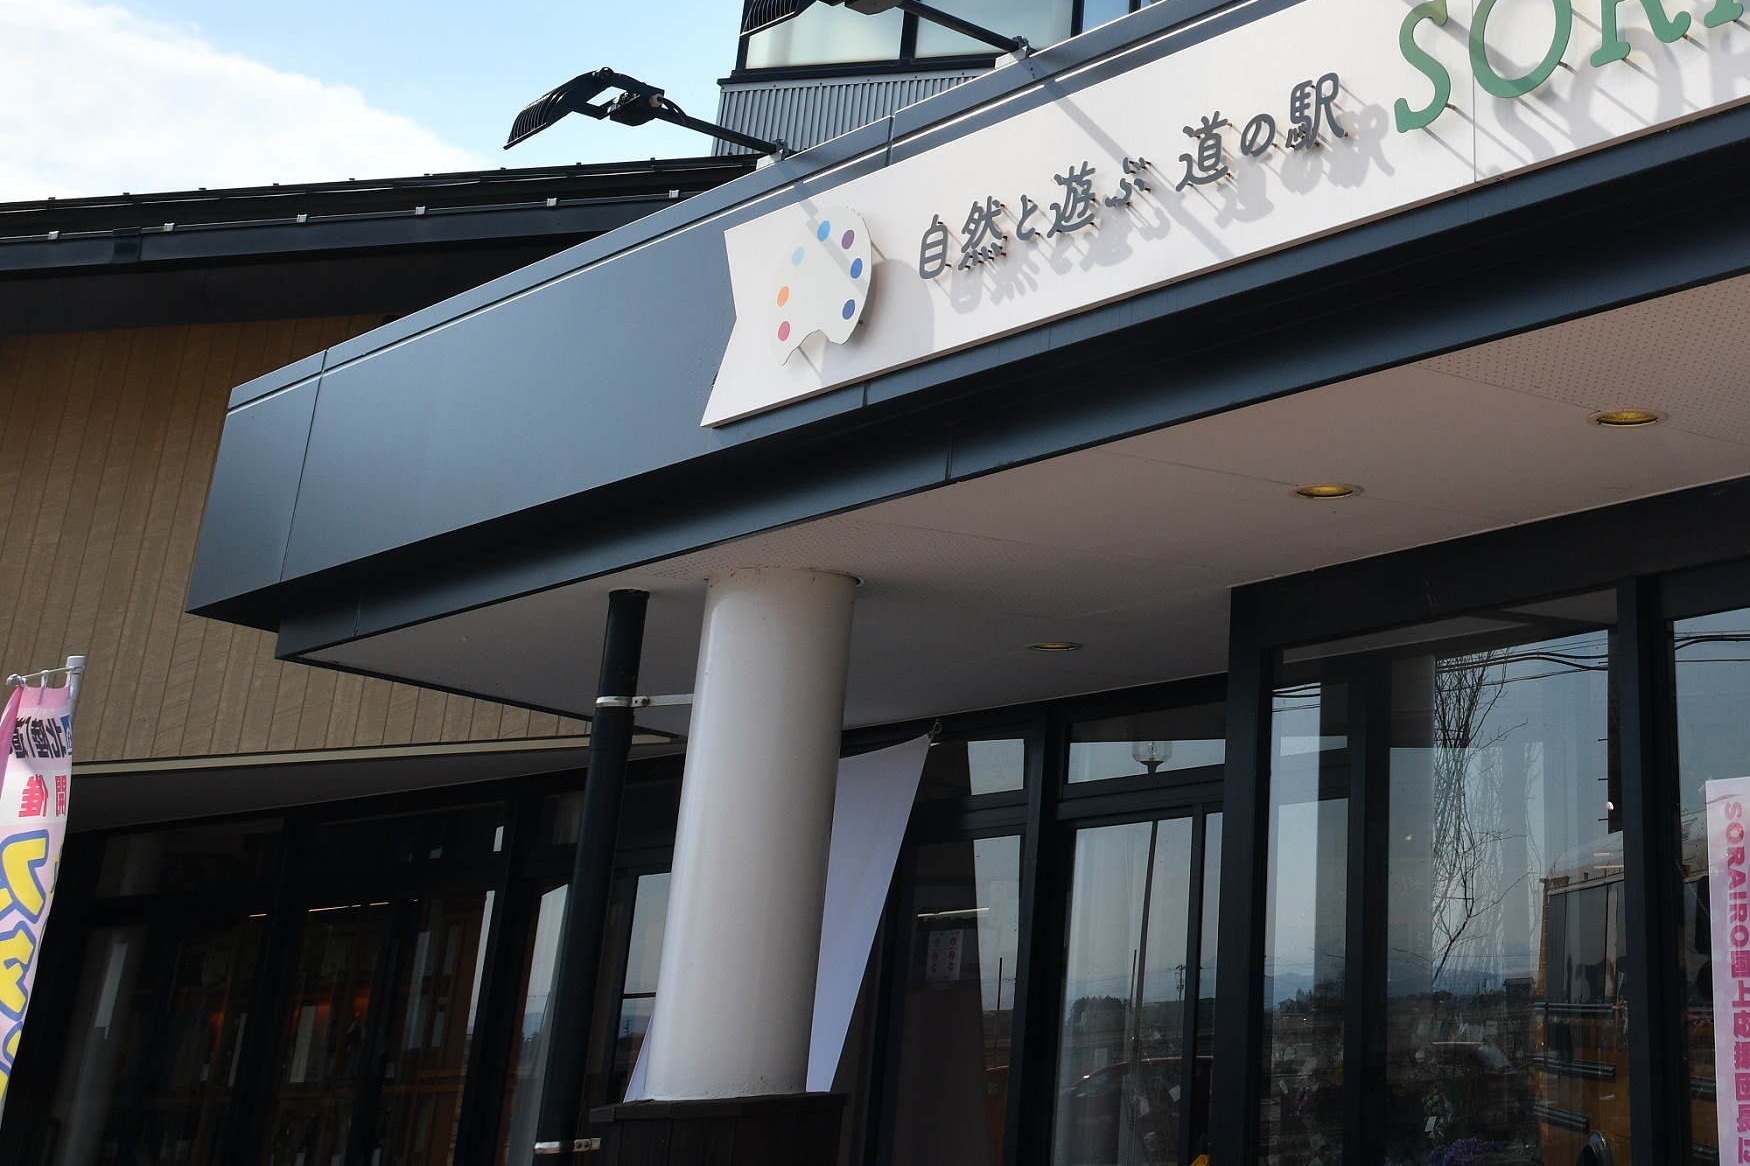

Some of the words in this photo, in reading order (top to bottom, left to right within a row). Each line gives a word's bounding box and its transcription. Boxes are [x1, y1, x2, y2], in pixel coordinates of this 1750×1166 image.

[919, 156, 1150, 280] 自然と遊ぶ
[1175, 71, 1345, 193] 道の駅
